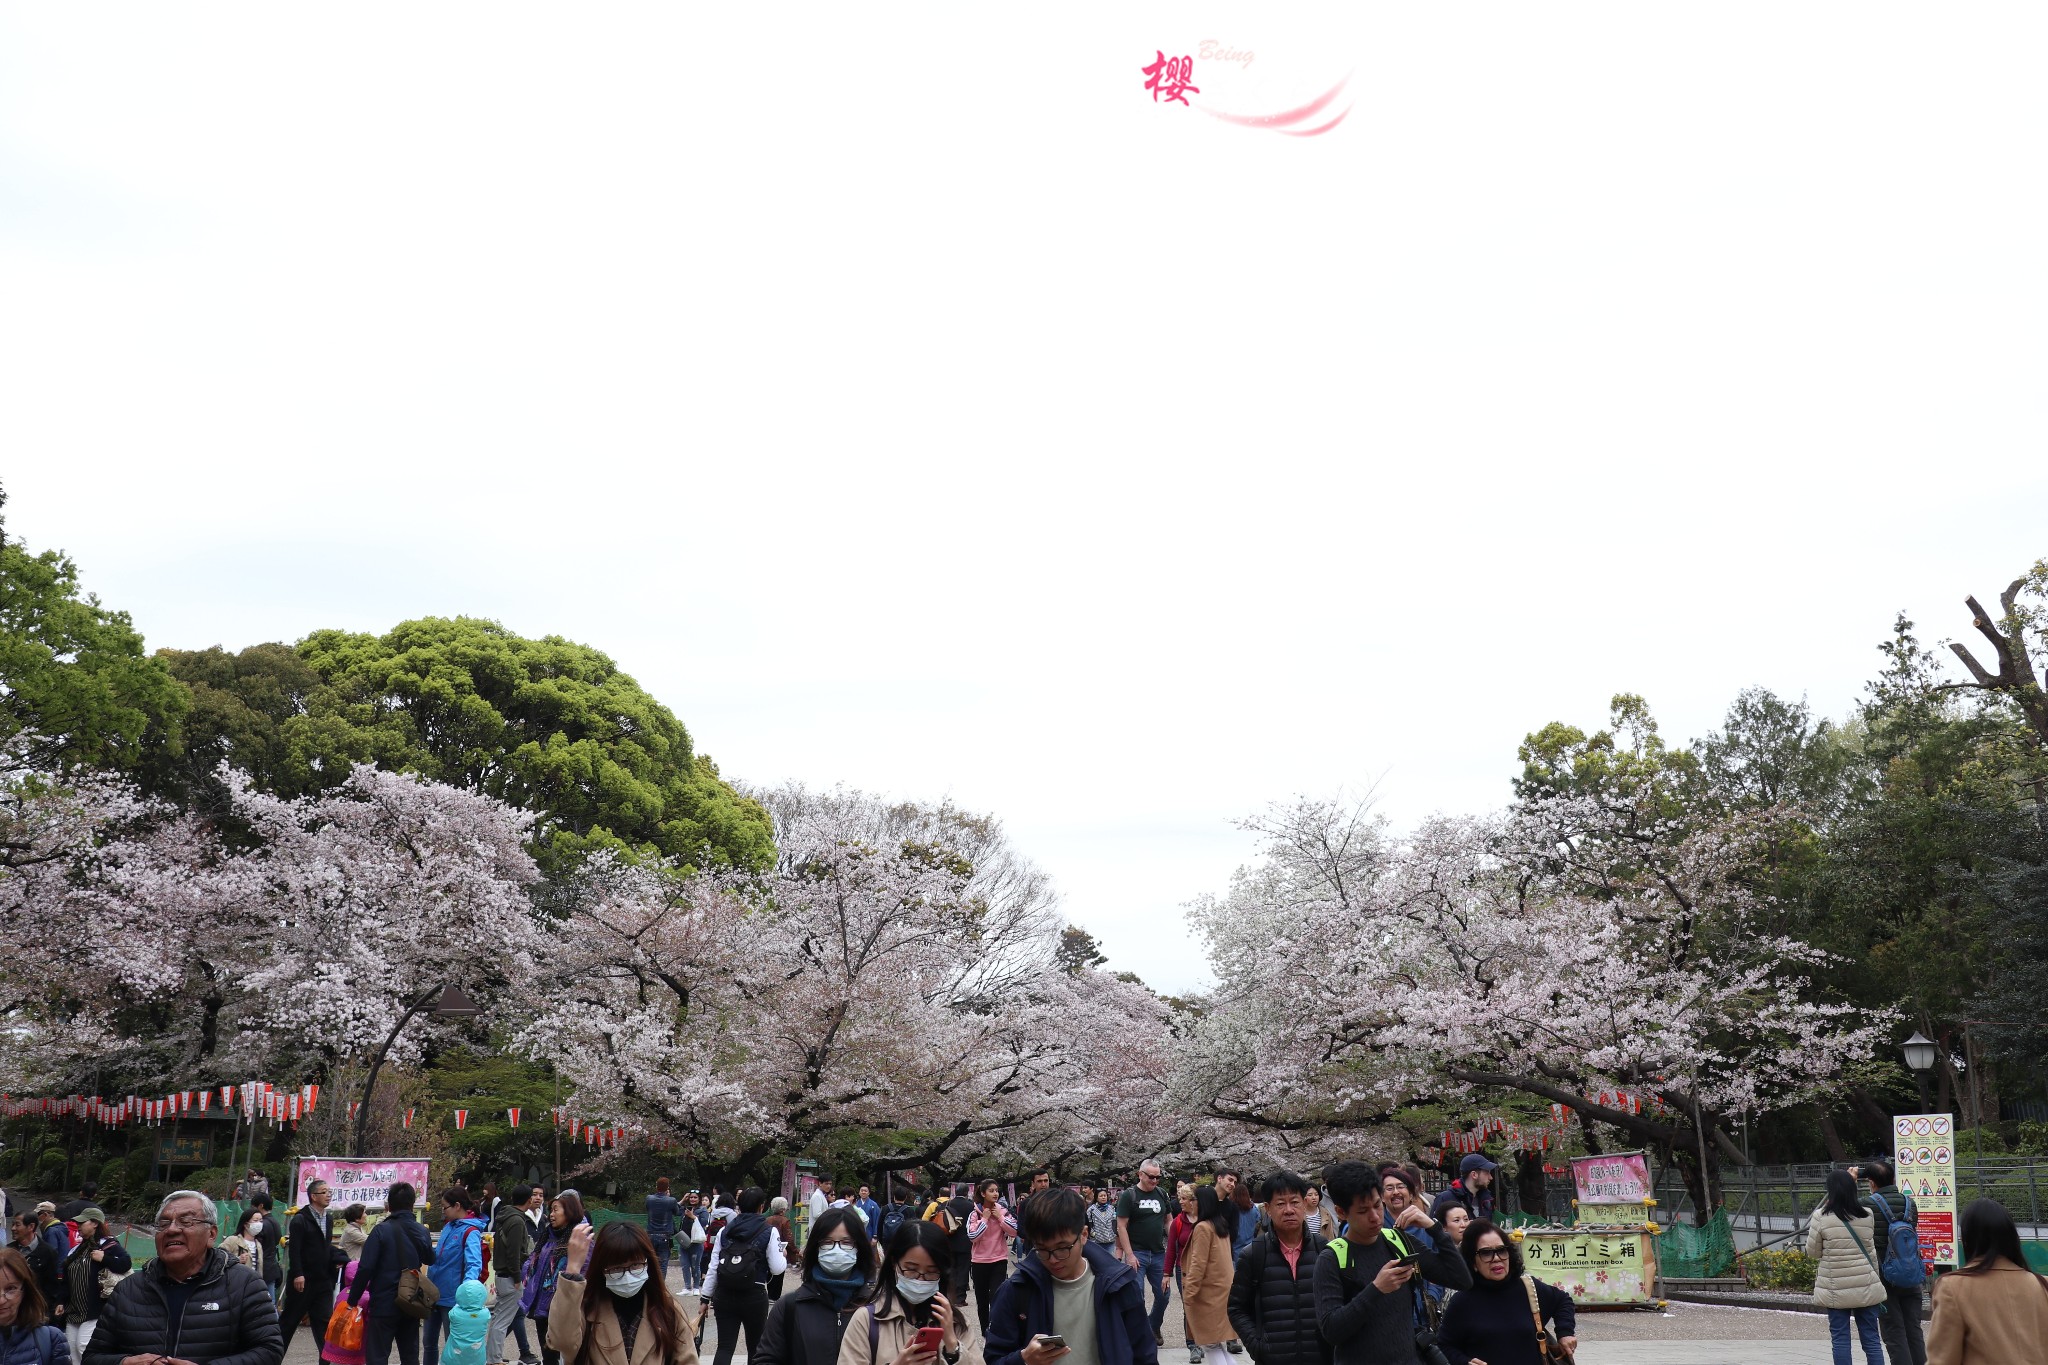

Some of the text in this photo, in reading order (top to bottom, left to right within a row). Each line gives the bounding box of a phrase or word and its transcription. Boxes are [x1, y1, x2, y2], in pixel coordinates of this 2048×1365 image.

[1528, 1241, 1635, 1259] 分別ゴミ箱
[1542, 1259, 1589, 1267] Classification
